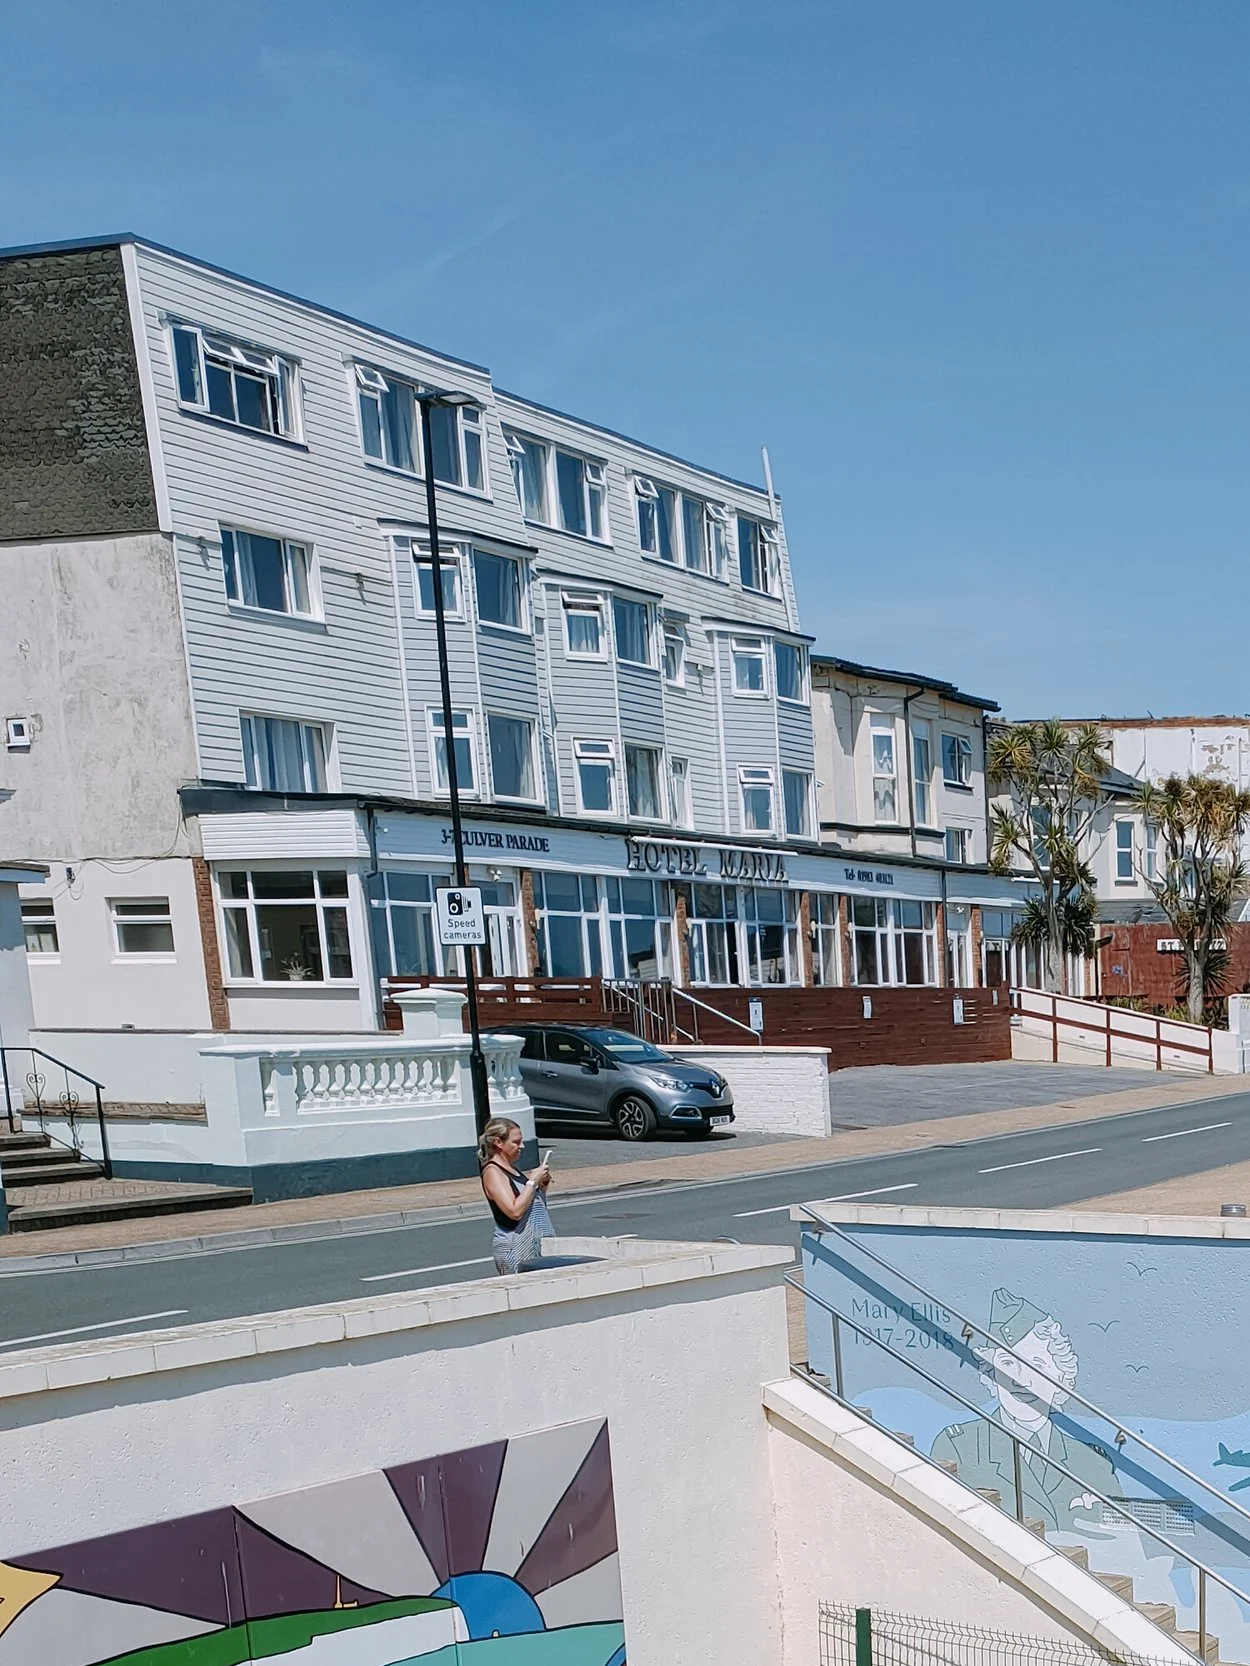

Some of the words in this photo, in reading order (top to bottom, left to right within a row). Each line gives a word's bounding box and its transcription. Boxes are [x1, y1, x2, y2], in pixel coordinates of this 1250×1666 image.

[460, 831, 504, 848] CULVER
[505, 834, 550, 852] PARADE
[625, 838, 707, 875] HOTEL
[719, 850, 789, 883] MARIA
[447, 919, 476, 929] Speed
[851, 1298, 904, 1324] Mary
[911, 1302, 951, 1323] Ellis
[854, 1327, 954, 1350] 1917-2018
